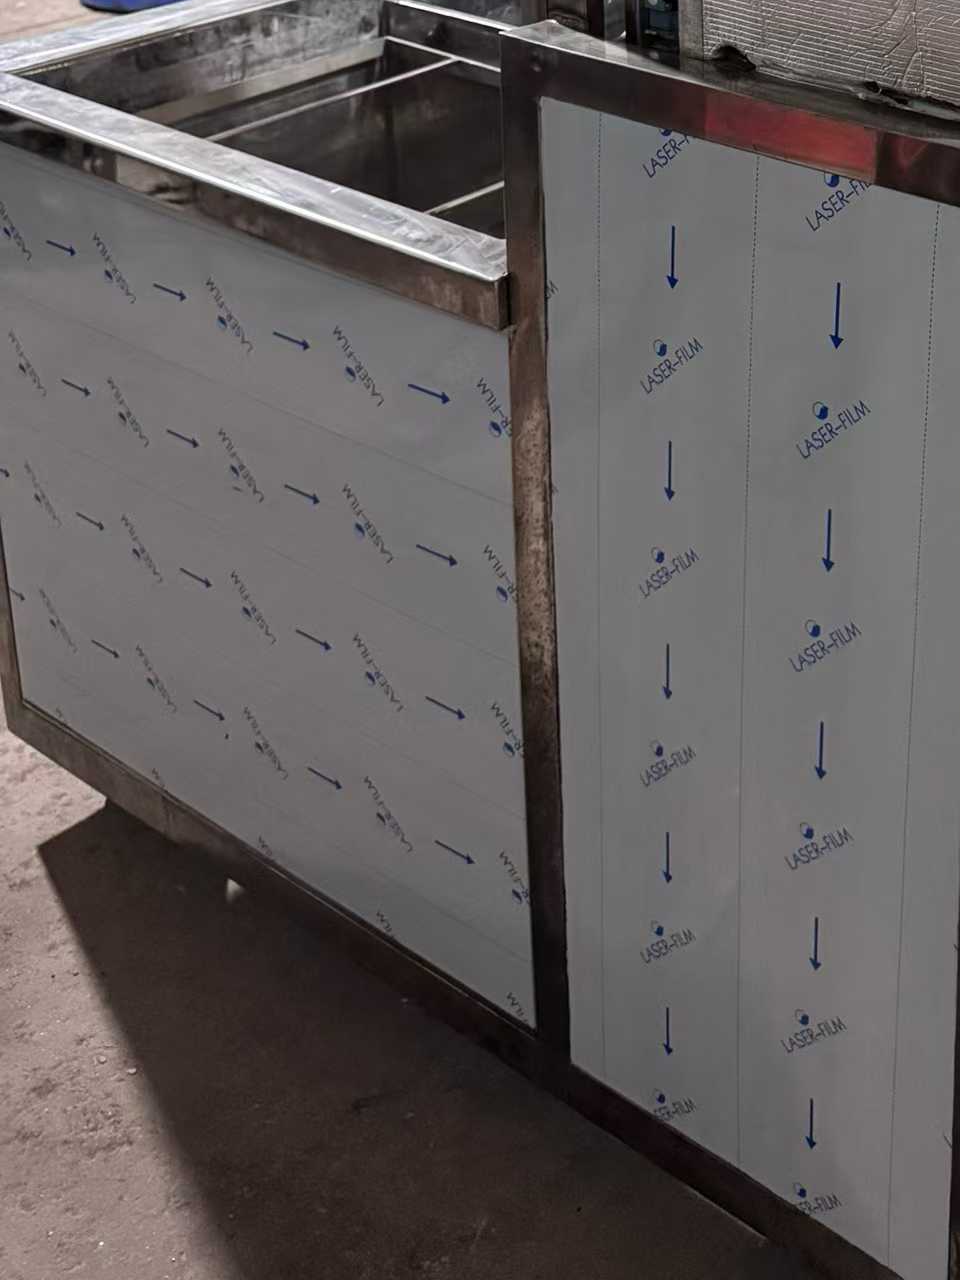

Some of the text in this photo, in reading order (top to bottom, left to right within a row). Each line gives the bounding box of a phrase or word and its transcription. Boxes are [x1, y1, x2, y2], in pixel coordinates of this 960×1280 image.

[332, 325, 385, 407] LASER-FILM
[640, 336, 704, 394] LASER-FILM
[796, 400, 871, 460] LASER-FILM
[342, 483, 393, 564] LASER-FILM
[639, 548, 700, 599] LASER-FILM
[353, 632, 404, 712] LASER-FILM
[788, 622, 862, 673] LASER-FILM
[640, 746, 697, 788] LASER-FILM
[784, 827, 854, 871] LASER-FILM
[640, 928, 697, 964] LASER-FILM
[780, 1016, 847, 1054] LASER-FILM
